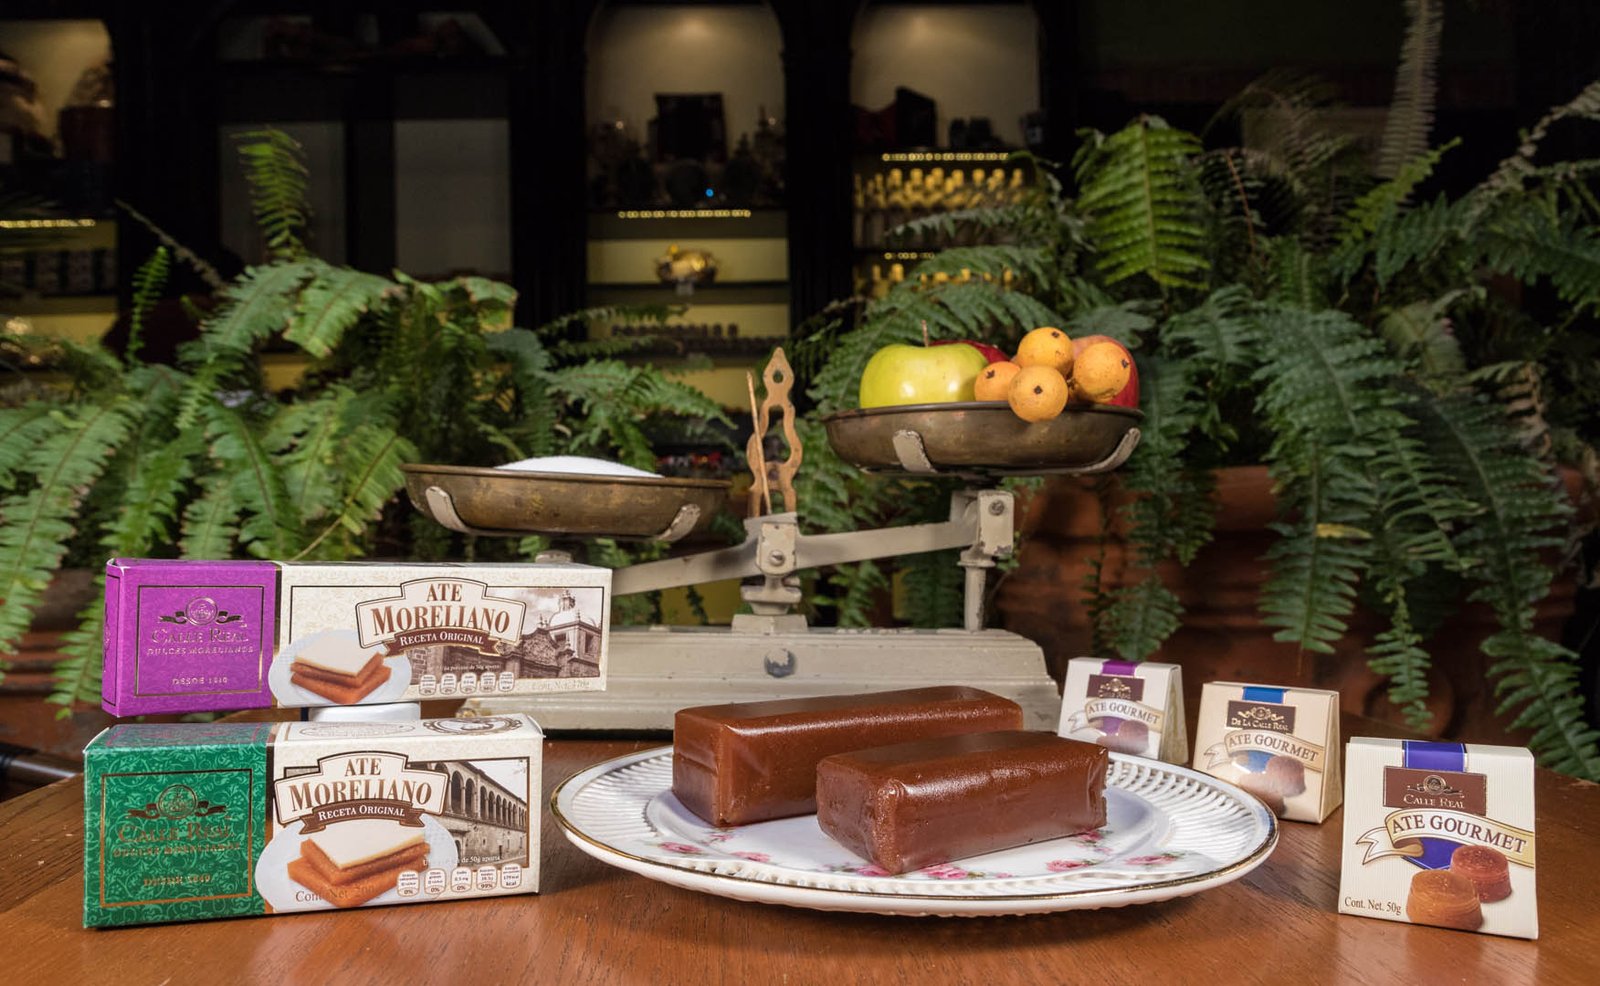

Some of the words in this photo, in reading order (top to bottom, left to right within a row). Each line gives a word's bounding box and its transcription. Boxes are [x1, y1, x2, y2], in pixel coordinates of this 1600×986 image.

[426, 583, 463, 602] ATE
[371, 605, 510, 636] MORELIANO
[400, 633, 437, 647] RECETA
[440, 631, 484, 645] ORIGINAL
[1089, 701, 1106, 714] ATE
[1109, 701, 1160, 724] GOURMET
[1229, 734, 1252, 747] ATE
[1254, 734, 1319, 762] GOURMET
[345, 758, 381, 777] ATE
[288, 778, 432, 812] MORELIANO
[318, 807, 357, 821] RECETA
[359, 804, 405, 818] ORIGINAL
[1392, 814, 1425, 835] ATE
[1430, 817, 1527, 854] GOURMET
[1344, 896, 1366, 909] Cont.
[1367, 899, 1384, 911] Net.
[1386, 902, 1401, 915] 50g
